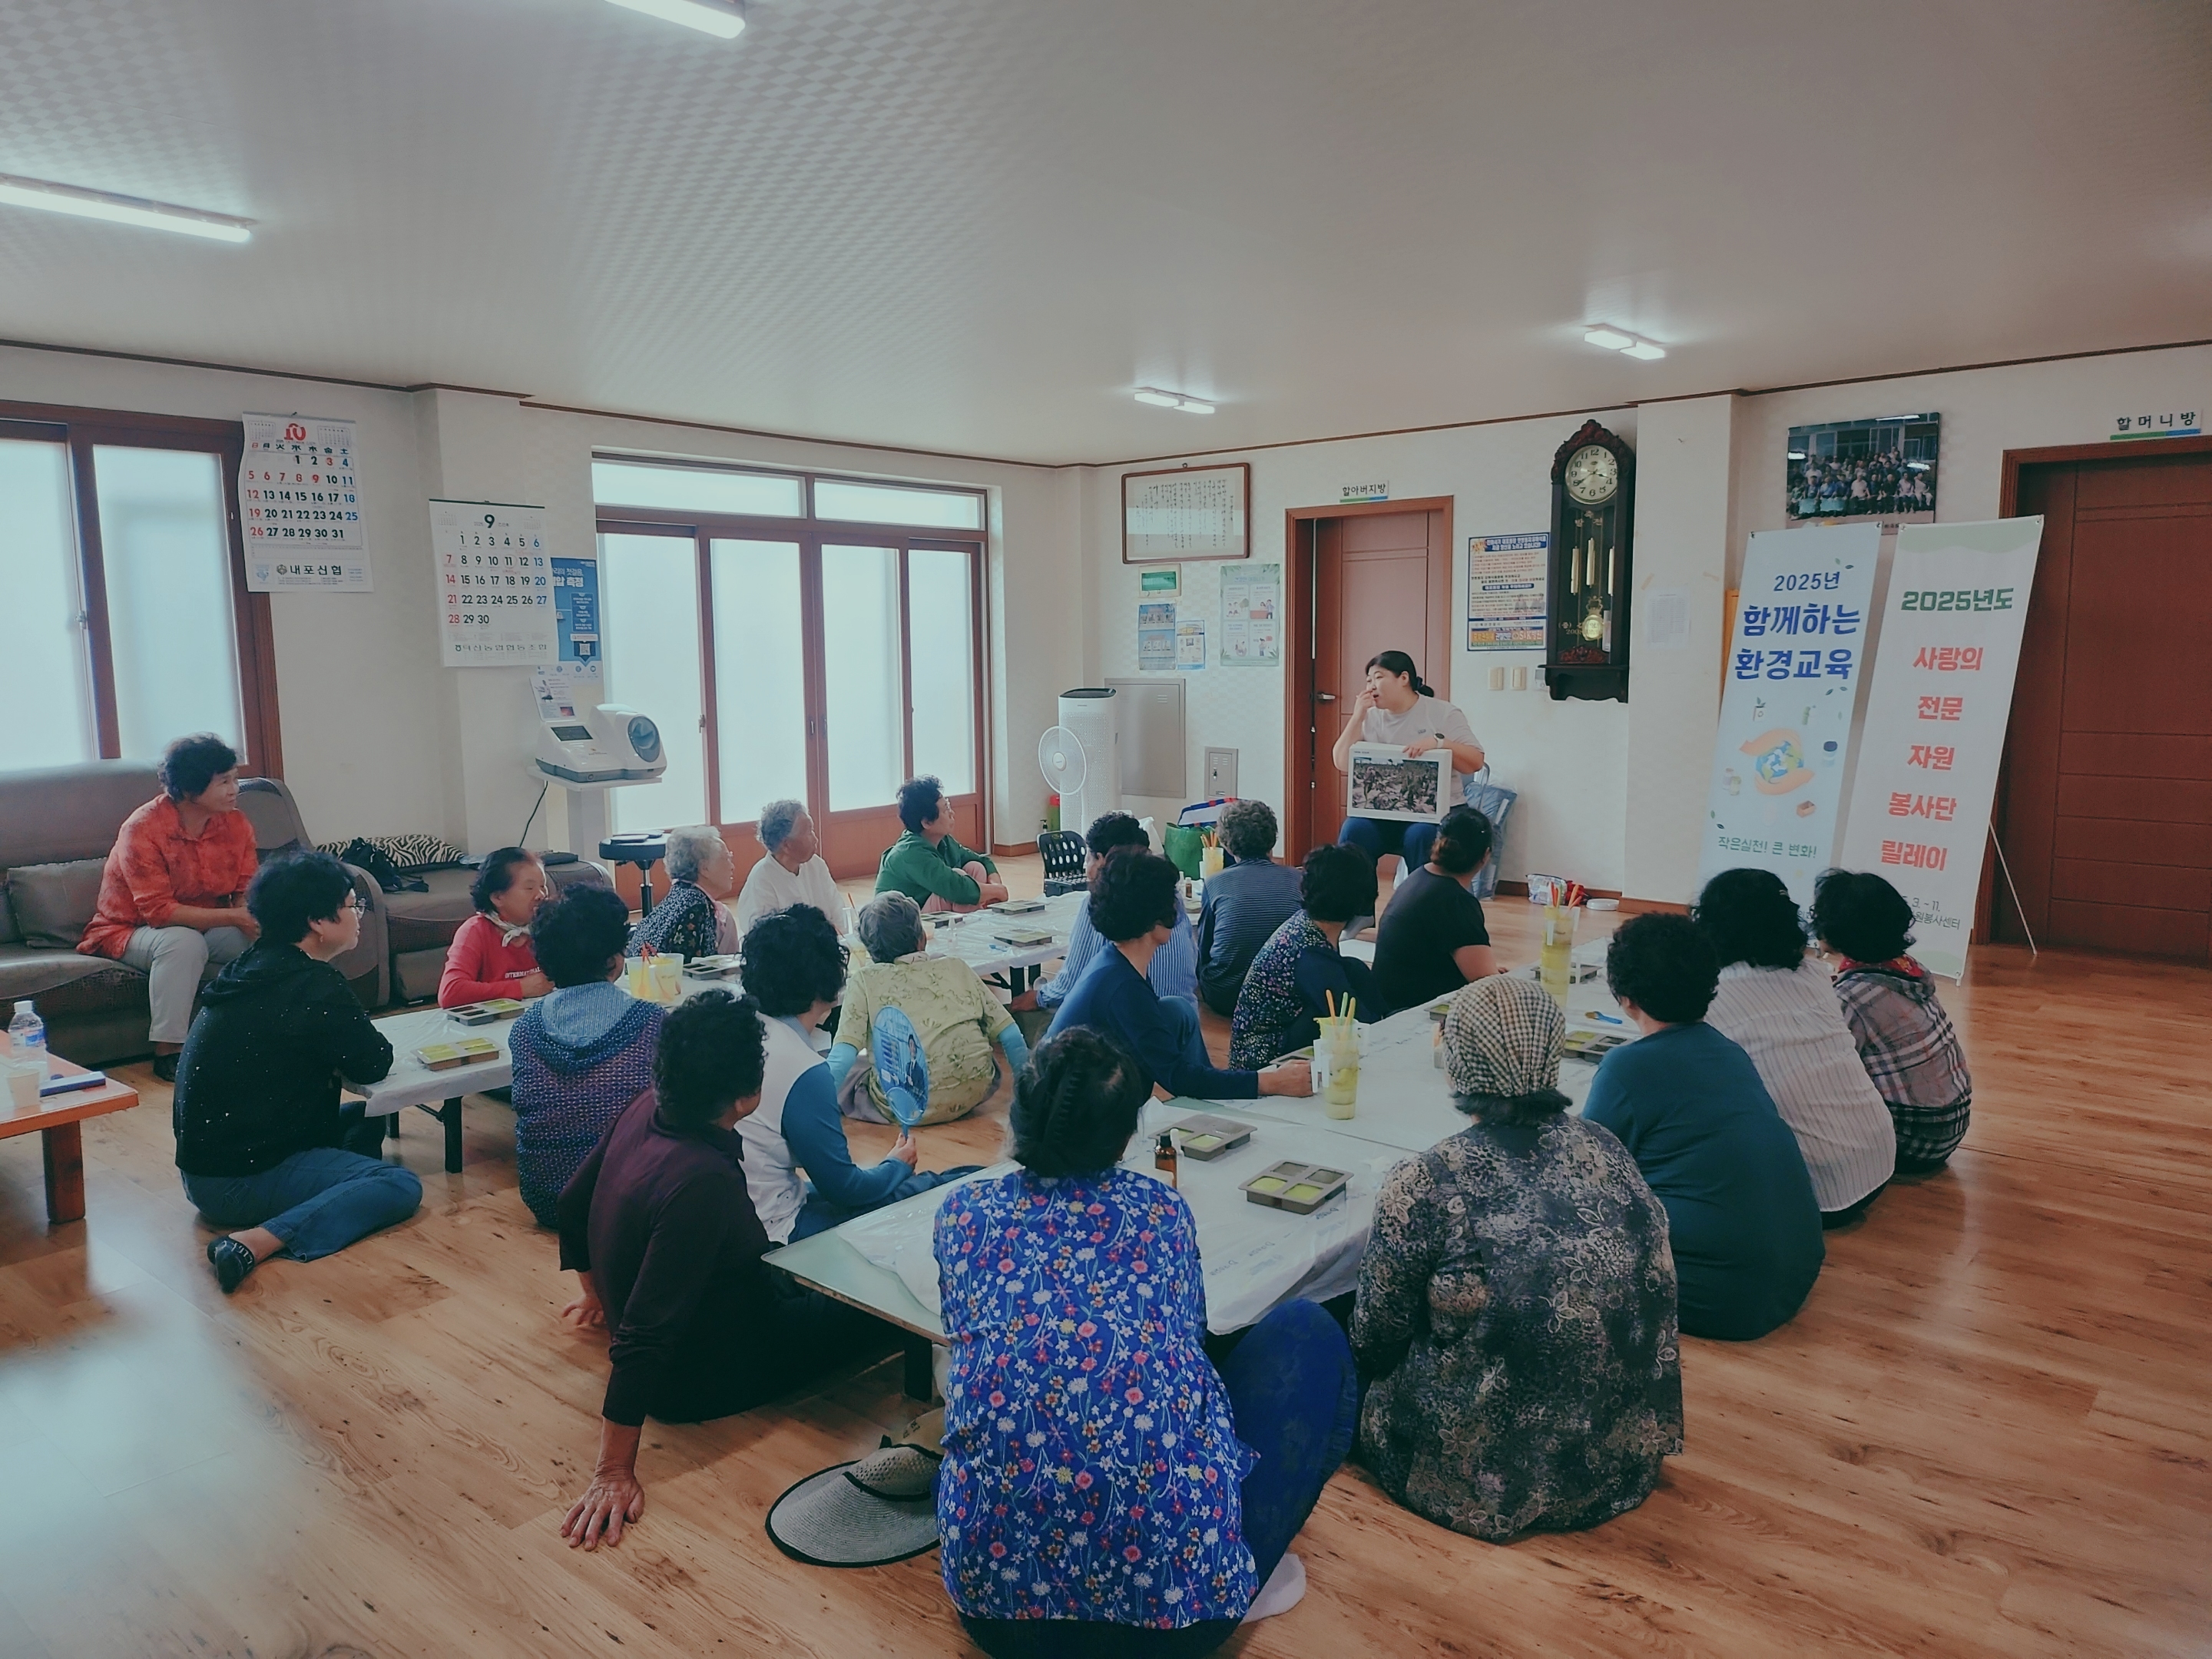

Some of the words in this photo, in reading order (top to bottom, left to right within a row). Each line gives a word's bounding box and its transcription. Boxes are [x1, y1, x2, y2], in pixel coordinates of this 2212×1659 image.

[2117, 412, 2196, 431] 할머니방
[291, 443, 301, 452] 水
[296, 455, 300, 464] 1
[264, 472, 270, 480] 6
[326, 475, 337, 484] 10
[343, 476, 353, 485] 11
[247, 490, 259, 498] 12
[263, 490, 274, 499] 13
[280, 492, 290, 500] 14
[296, 492, 306, 501] 15
[312, 492, 323, 501] 16
[329, 493, 339, 502] 17
[1343, 483, 1386, 496] 할아버지방
[265, 509, 277, 518] 20
[282, 510, 293, 518] 21
[296, 511, 309, 519] 22
[329, 512, 343, 520] 24
[484, 514, 495, 528] 9
[250, 528, 263, 536] 26
[267, 528, 278, 536] 27
[283, 528, 294, 537] 28
[315, 529, 327, 538] 30
[461, 535, 464, 544] 1
[475, 537, 480, 545] 2
[505, 538, 510, 546] 4
[519, 538, 525, 547] 5
[446, 555, 452, 564] 7
[476, 556, 481, 565] 9
[488, 556, 498, 565] 10
[505, 557, 512, 565] 11
[535, 558, 543, 567] 13
[290, 565, 342, 575] 내포신협
[446, 575, 455, 584] 14
[461, 575, 470, 584] 15
[475, 576, 485, 584] 16
[491, 576, 499, 584] 17
[505, 577, 515, 585] 18
[521, 577, 530, 585] 19
[566, 577, 584, 587] 측정
[1773, 571, 1839, 591] 2025년
[448, 594, 456, 604] 21
[462, 595, 473, 604] 22
[476, 595, 487, 604] 23
[507, 596, 518, 604] 25
[522, 596, 532, 604] 26
[537, 596, 547, 604] 27
[1901, 588, 2014, 611] 2025년도
[449, 615, 459, 624] 28
[463, 615, 474, 624] 29
[478, 615, 488, 624] 30
[1743, 603, 1860, 636] 함께하는
[1735, 648, 1853, 680] 환경교육
[1912, 647, 1983, 671] 사랑의
[1918, 696, 1963, 720] 전문
[1907, 744, 1955, 771] 자원
[1888, 792, 1957, 822] 봉사단
[1718, 836, 1767, 853] 작은실천!
[1773, 842, 1783, 856] 큰
[1789, 843, 1817, 859] 변화!
[1881, 839, 1948, 871] 릴레이
[1912, 910, 1961, 930] 원봉사센터
